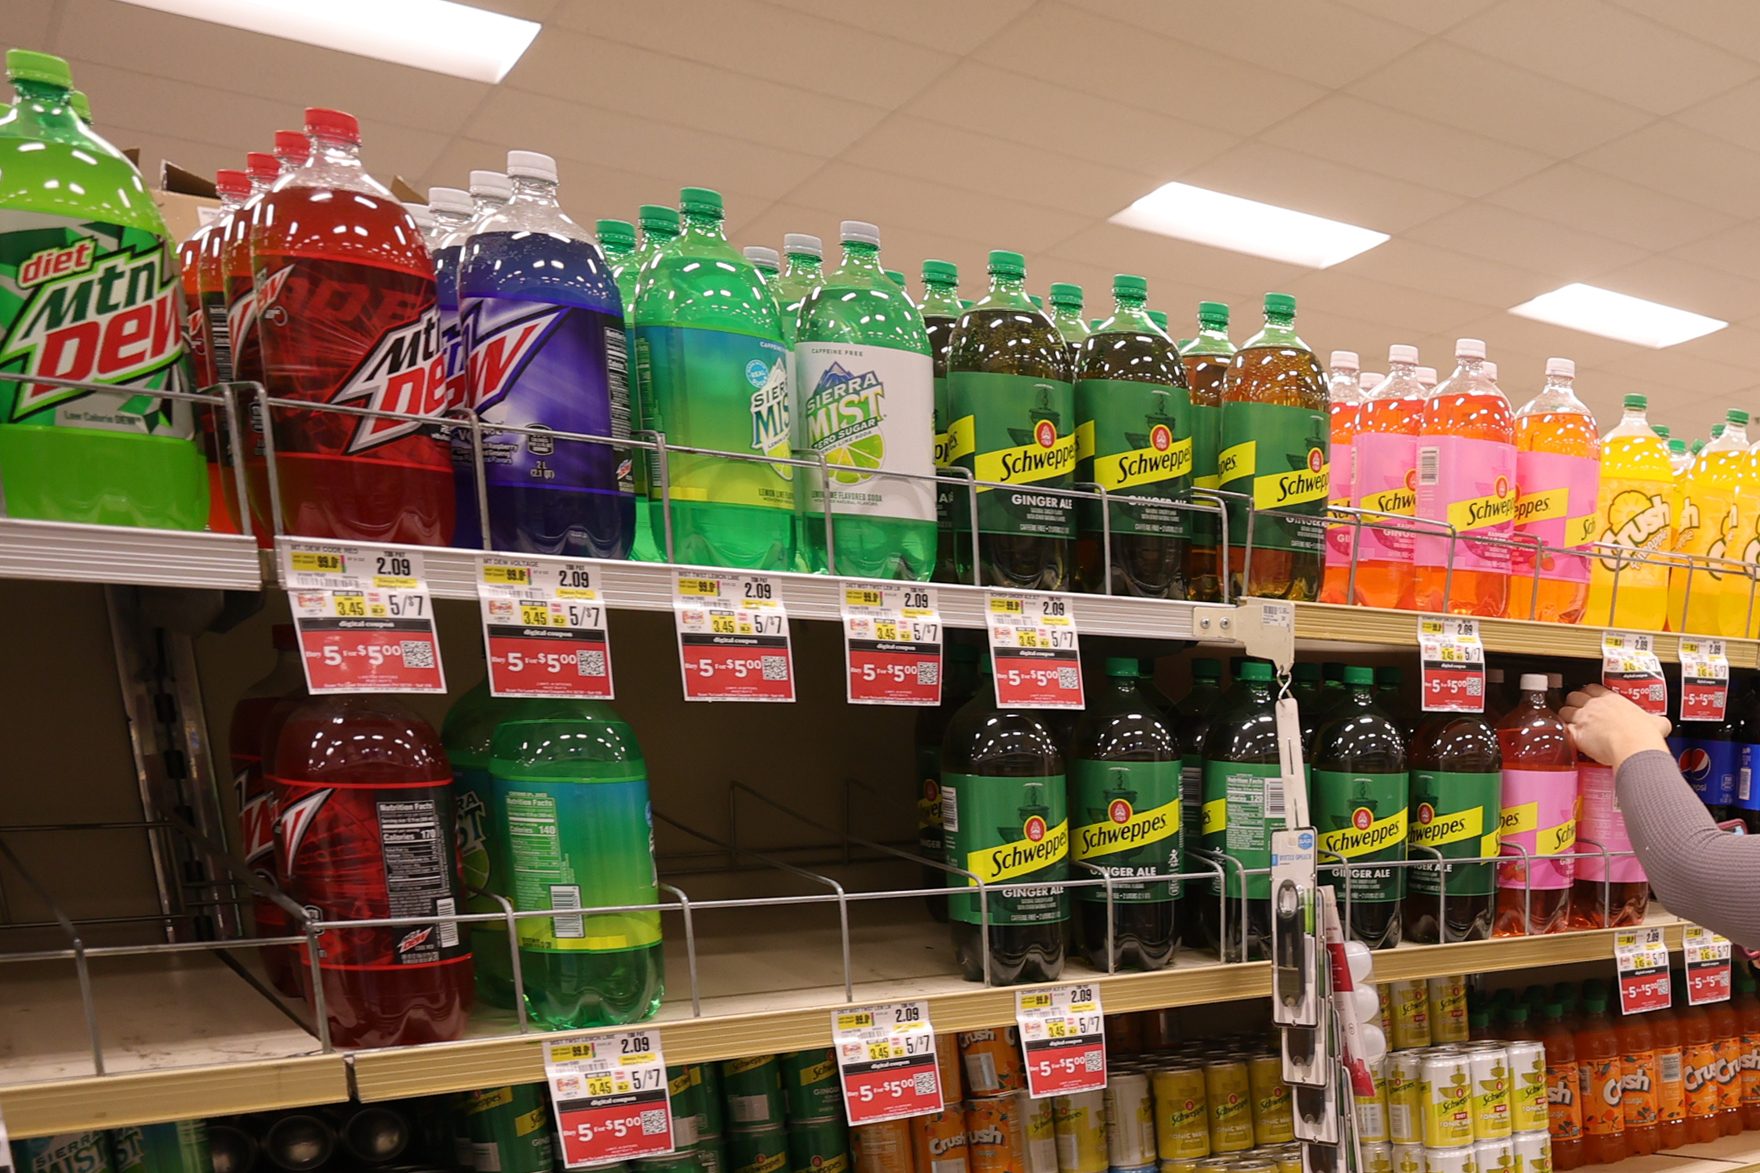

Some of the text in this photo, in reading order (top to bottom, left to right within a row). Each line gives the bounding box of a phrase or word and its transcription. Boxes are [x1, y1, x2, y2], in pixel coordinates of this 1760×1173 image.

[22, 243, 90, 283] diet
[20, 262, 155, 341] Mtn
[811, 348, 842, 356] CAFFEINE
[806, 373, 879, 414] SIERRA
[808, 385, 884, 446] MIST
[838, 418, 877, 438] SUGAR
[1011, 493, 1073, 510] GINGER ALE
[377, 557, 411, 576] 2.09
[559, 570, 589, 588] 2.09
[745, 581, 772, 599] 2.09
[338, 601, 364, 616] 3.45
[1043, 600, 1065, 616] 2.09
[524, 610, 548, 625] 3.45
[323, 645, 342, 666] 5
[380, 802, 433, 812] Nutrition Facts
[383, 828, 436, 842] Calories 170
[538, 825, 556, 835] 140
[1081, 812, 1167, 854] Schweppes
[1325, 818, 1400, 852] Schweppes
[1136, 866, 1157, 877] ALE
[1373, 867, 1391, 878] ALE
[895, 1007, 919, 1023] 2.09
[621, 1036, 650, 1054] 2.09
[589, 1081, 612, 1096] 3.45
[578, 1123, 593, 1142] 5
[1440, 1120, 1461, 1129] TONIC
